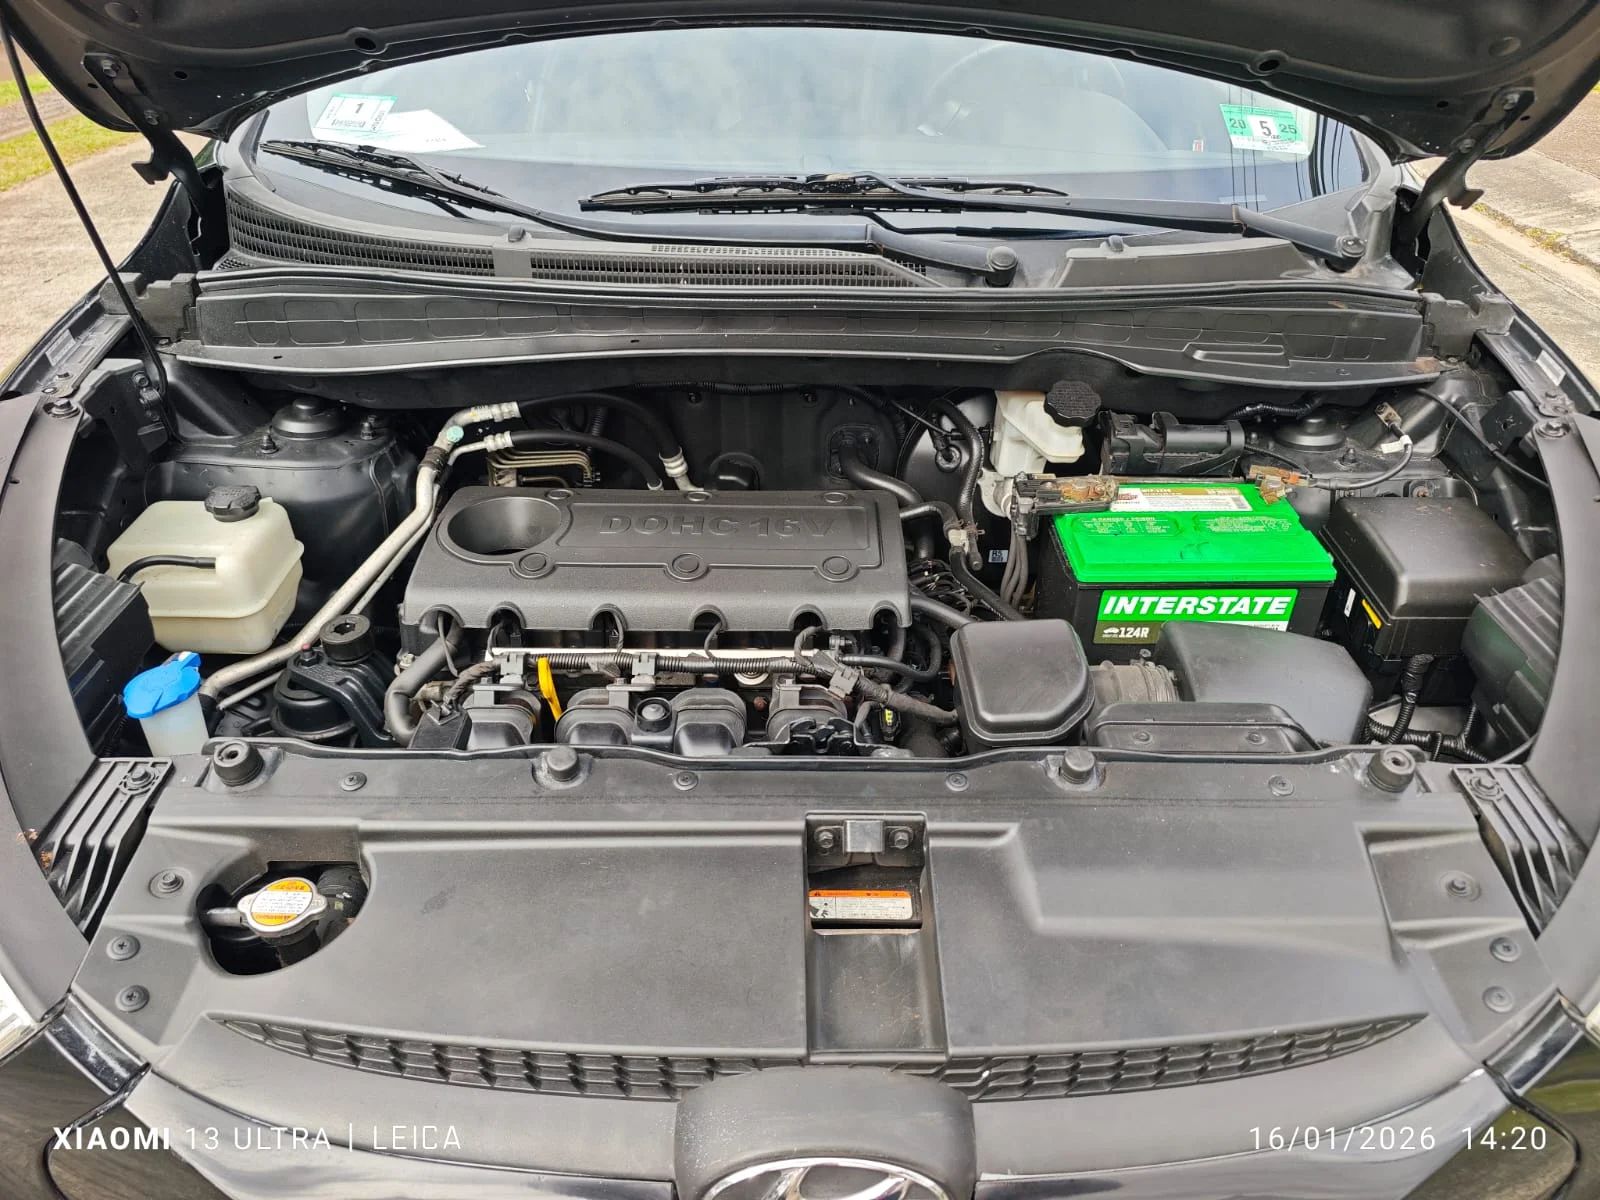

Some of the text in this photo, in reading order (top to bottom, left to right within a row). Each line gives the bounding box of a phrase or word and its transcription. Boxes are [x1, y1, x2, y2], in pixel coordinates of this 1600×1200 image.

[1229, 118, 1246, 129] 20
[1259, 120, 1272, 137] 5
[1279, 123, 1297, 134] 25
[600, 514, 835, 537] DOHC 16V
[1103, 596, 1291, 615] INTERSTATE
[1119, 627, 1150, 638] 124R
